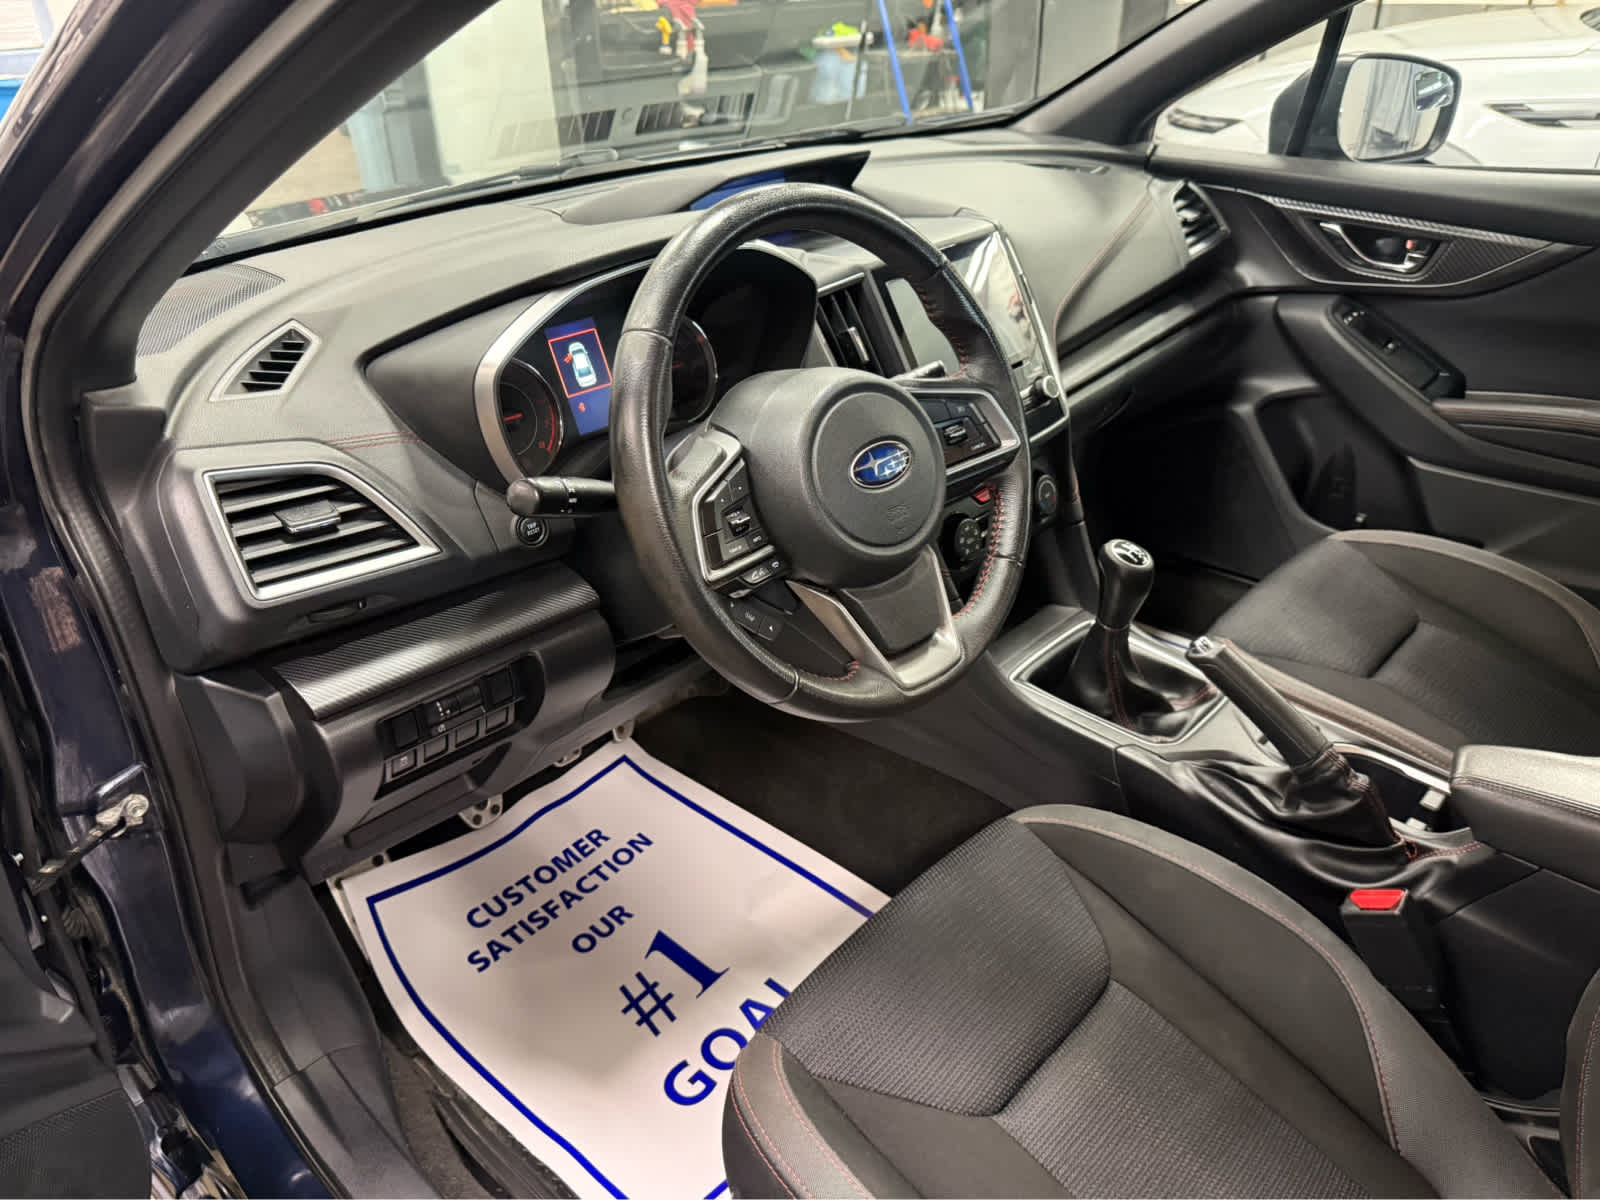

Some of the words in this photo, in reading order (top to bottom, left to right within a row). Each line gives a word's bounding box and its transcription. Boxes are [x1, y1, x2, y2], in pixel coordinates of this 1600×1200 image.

[466, 828, 611, 929] CUSTOMER
[466, 832, 654, 973] SATISFACTION
[571, 905, 634, 954] OUR
[619, 929, 730, 1037] #1
